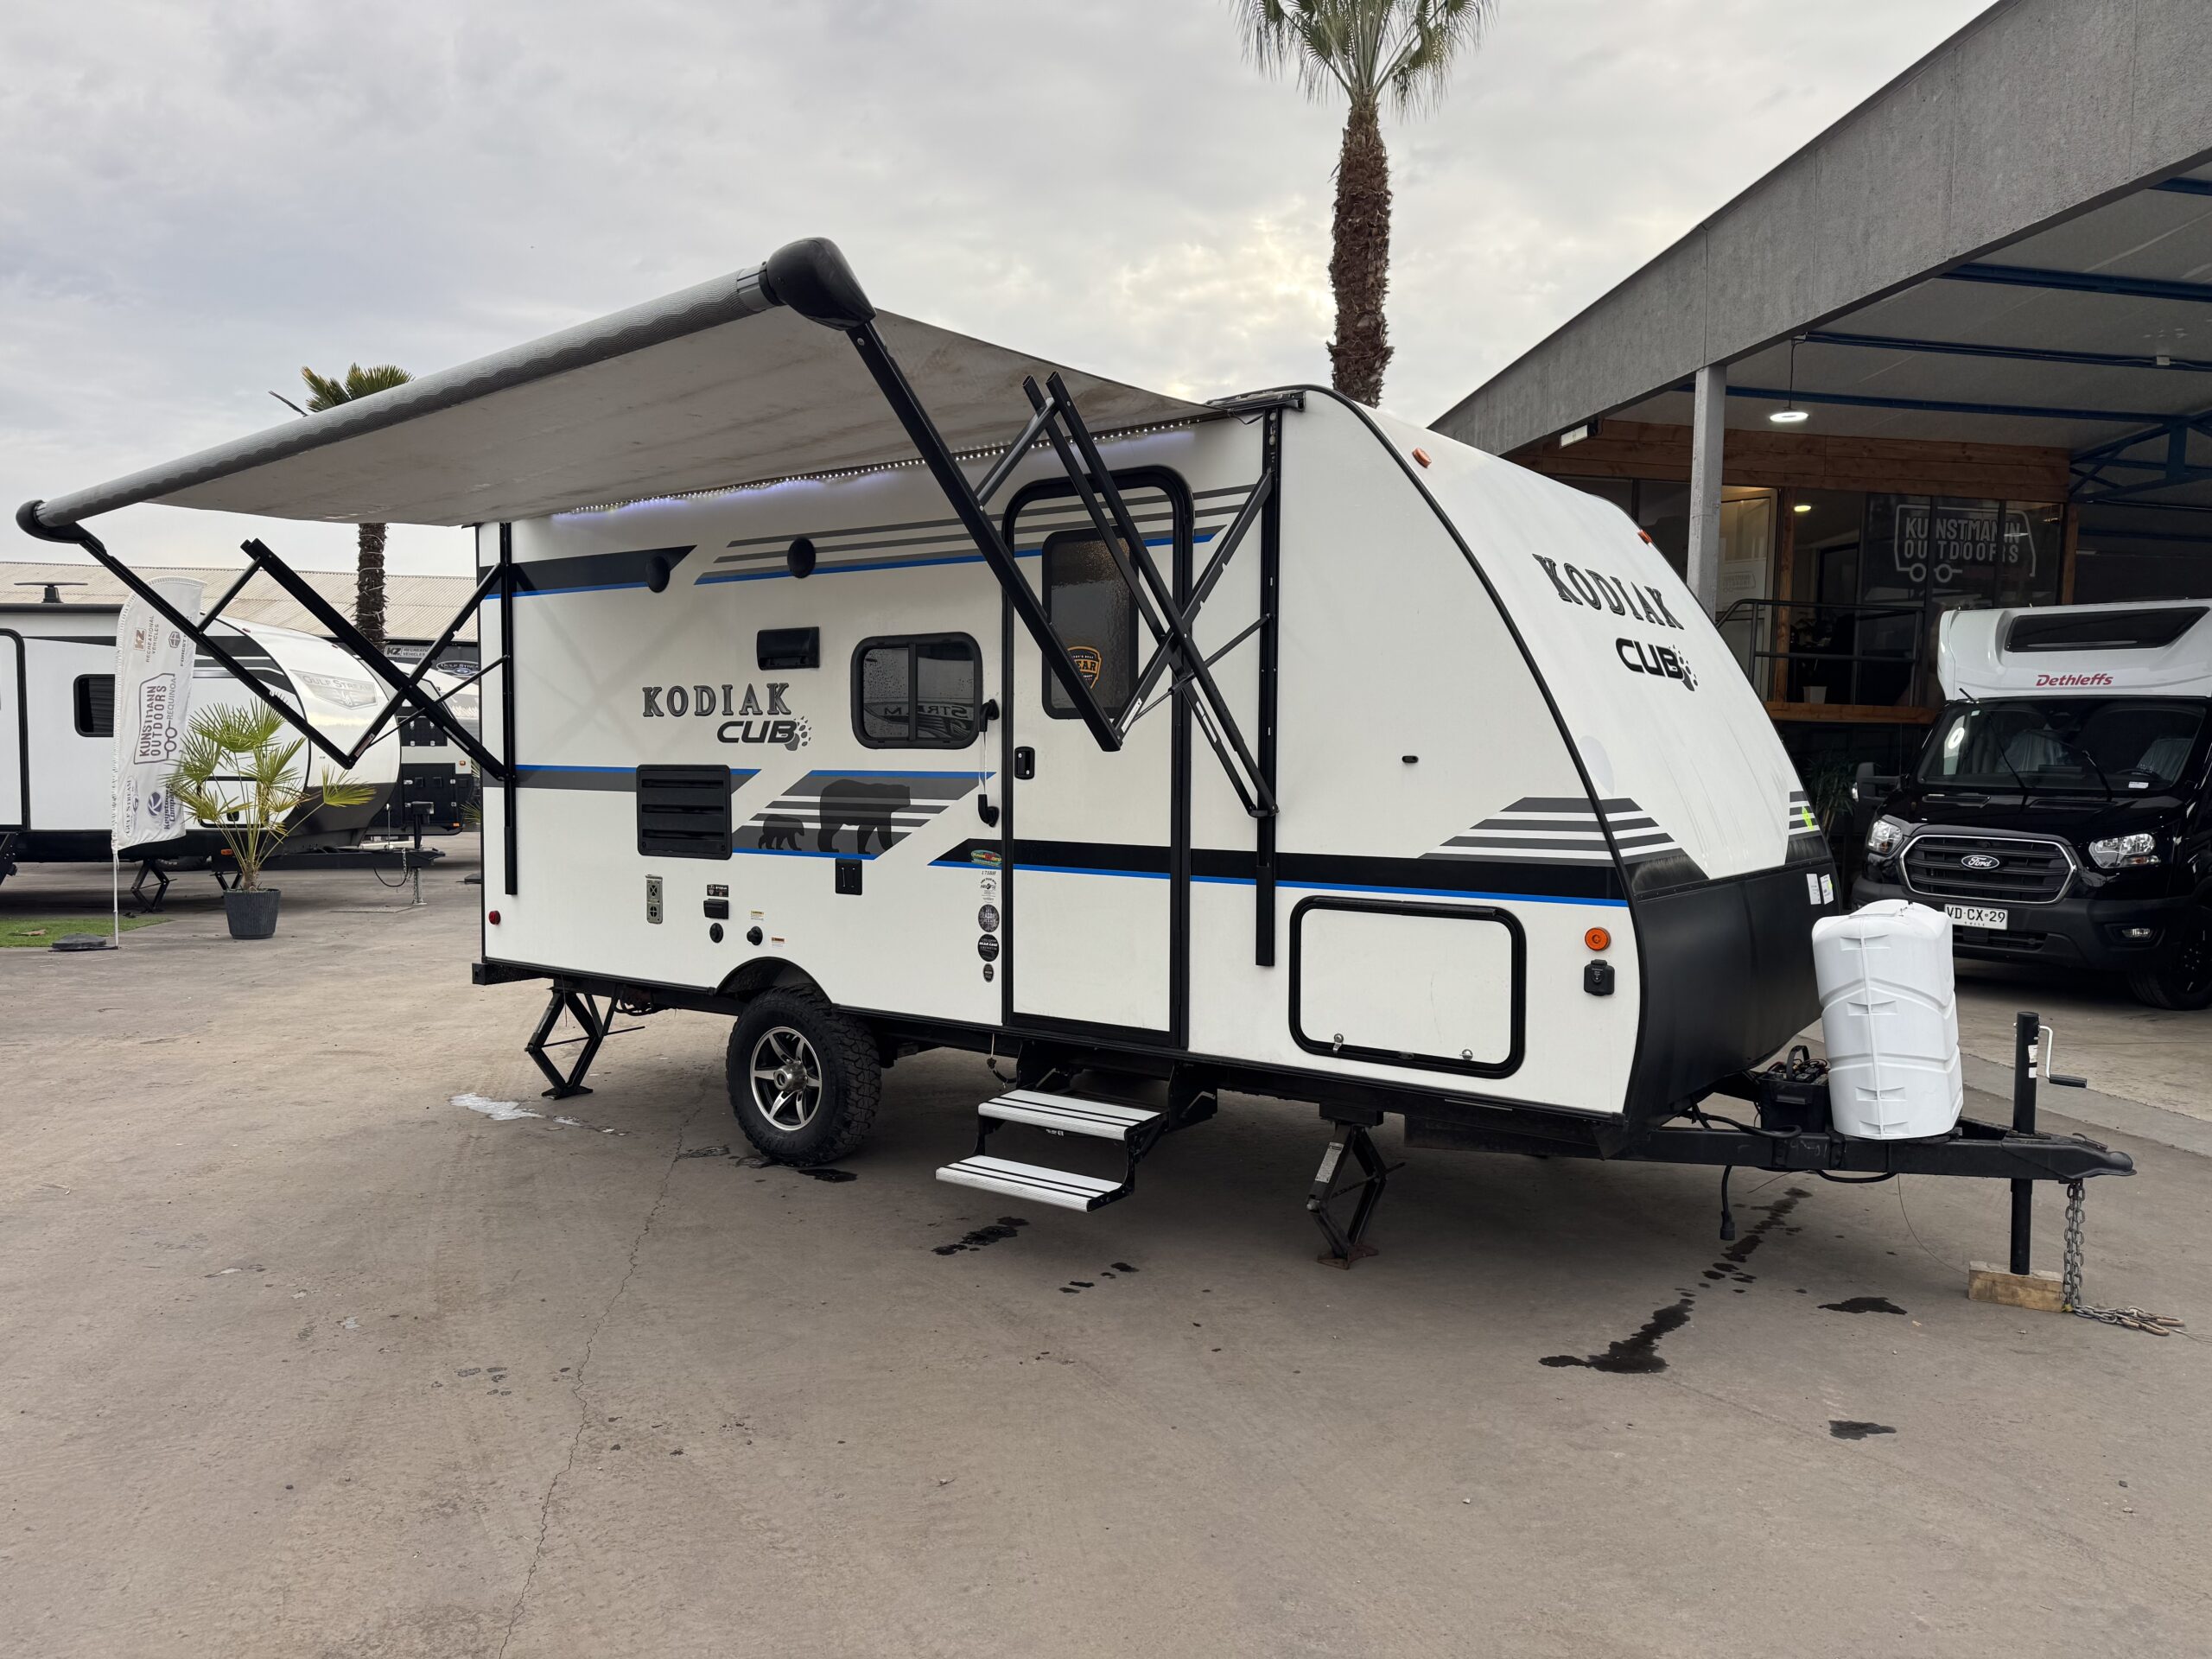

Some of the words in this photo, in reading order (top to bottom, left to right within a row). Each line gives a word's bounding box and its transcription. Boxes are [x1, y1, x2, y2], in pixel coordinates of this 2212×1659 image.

[1906, 517, 2020, 543] KUNSTMANN
[1904, 539, 2018, 563] OUTDOORS
[1532, 553, 1685, 630] KODIAK
[135, 629, 144, 650] KZ
[386, 647, 401, 656] KZ
[1616, 637, 1683, 680] CUB
[303, 676, 331, 686] GULF
[333, 679, 373, 690] STREAM
[2036, 673, 2113, 687] Dethleffs
[642, 683, 792, 717] KODIAK
[139, 685, 156, 757] KUNSTMANN
[150, 685, 167, 756] OUTDOORS
[717, 721, 798, 744] CUB
[1968, 856, 1992, 867] Ford
